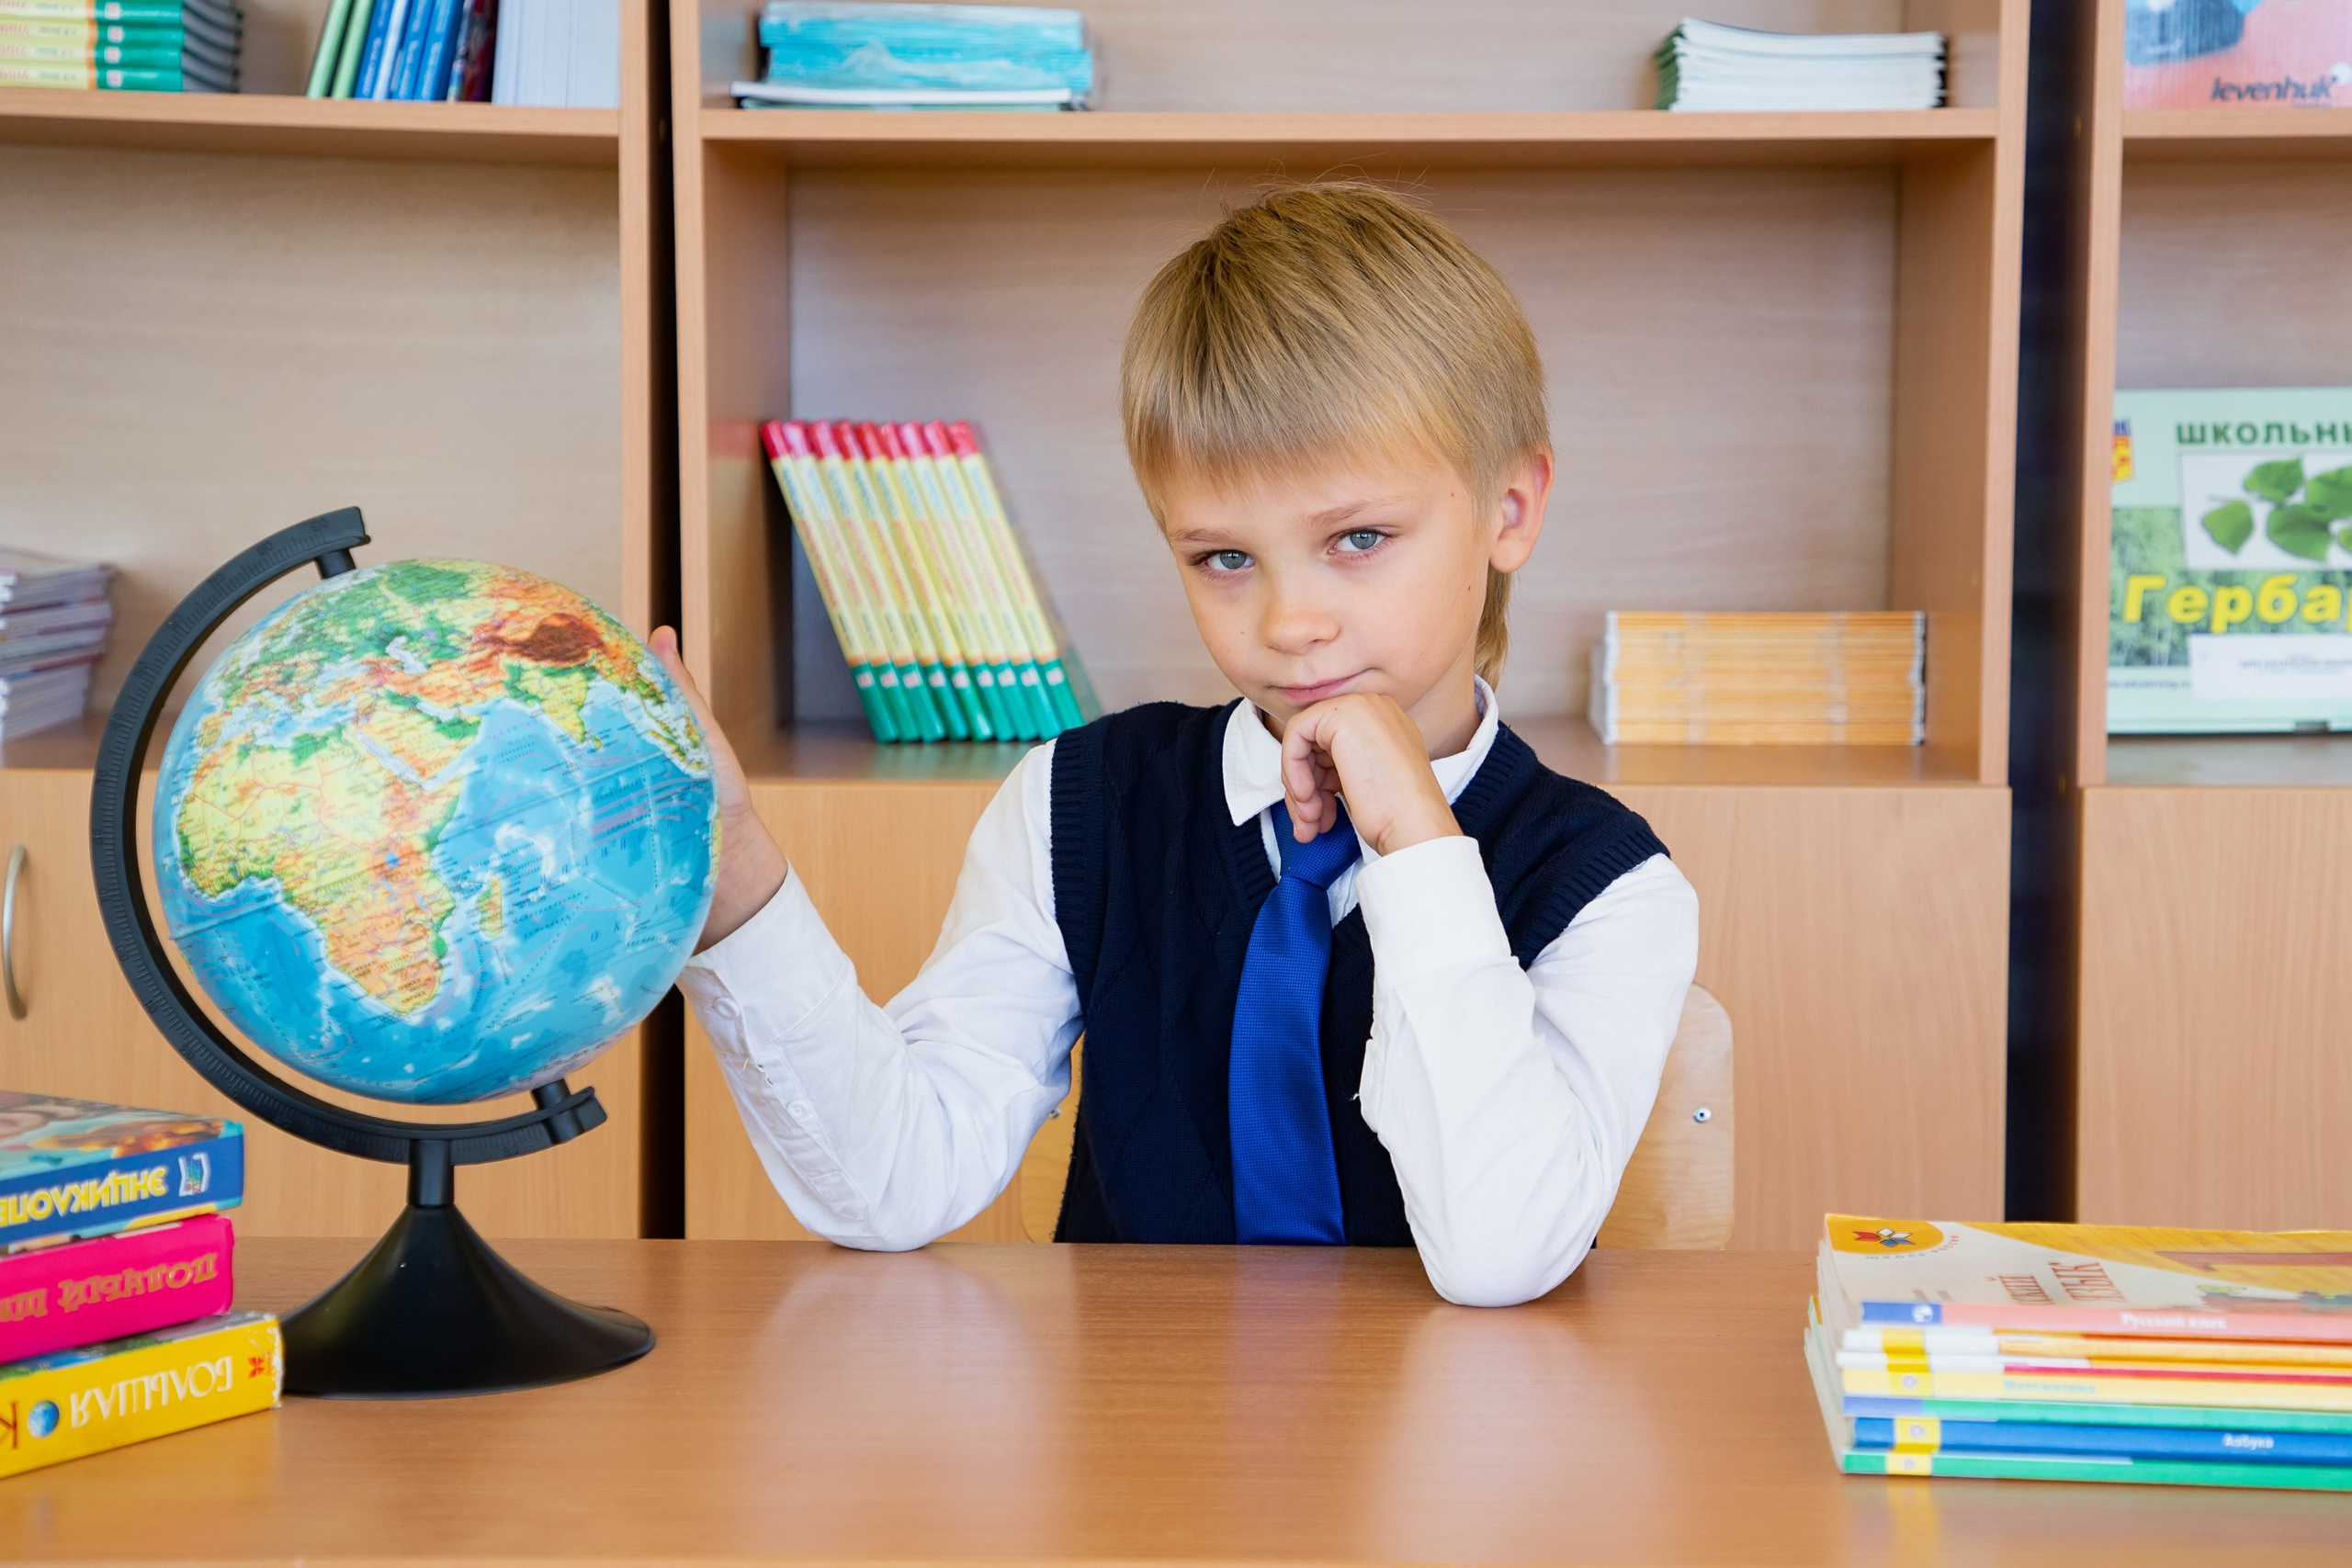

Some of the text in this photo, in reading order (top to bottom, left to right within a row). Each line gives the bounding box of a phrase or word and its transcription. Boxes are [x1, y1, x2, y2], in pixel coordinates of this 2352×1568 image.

[2211, 75, 2331, 102] levenhuk
[2123, 573, 2352, 634] Герба
[1866, 1251, 1927, 1260] ШКОЛА
[57, 1252, 219, 1314] ПОЛНЫЙ
[2048, 1261, 2129, 1303] ЯЗЫК
[2120, 1311, 2186, 1331] Русский
[70, 1355, 233, 1429] БОЛЬШАЯ
[2222, 1432, 2275, 1450] Азбука
